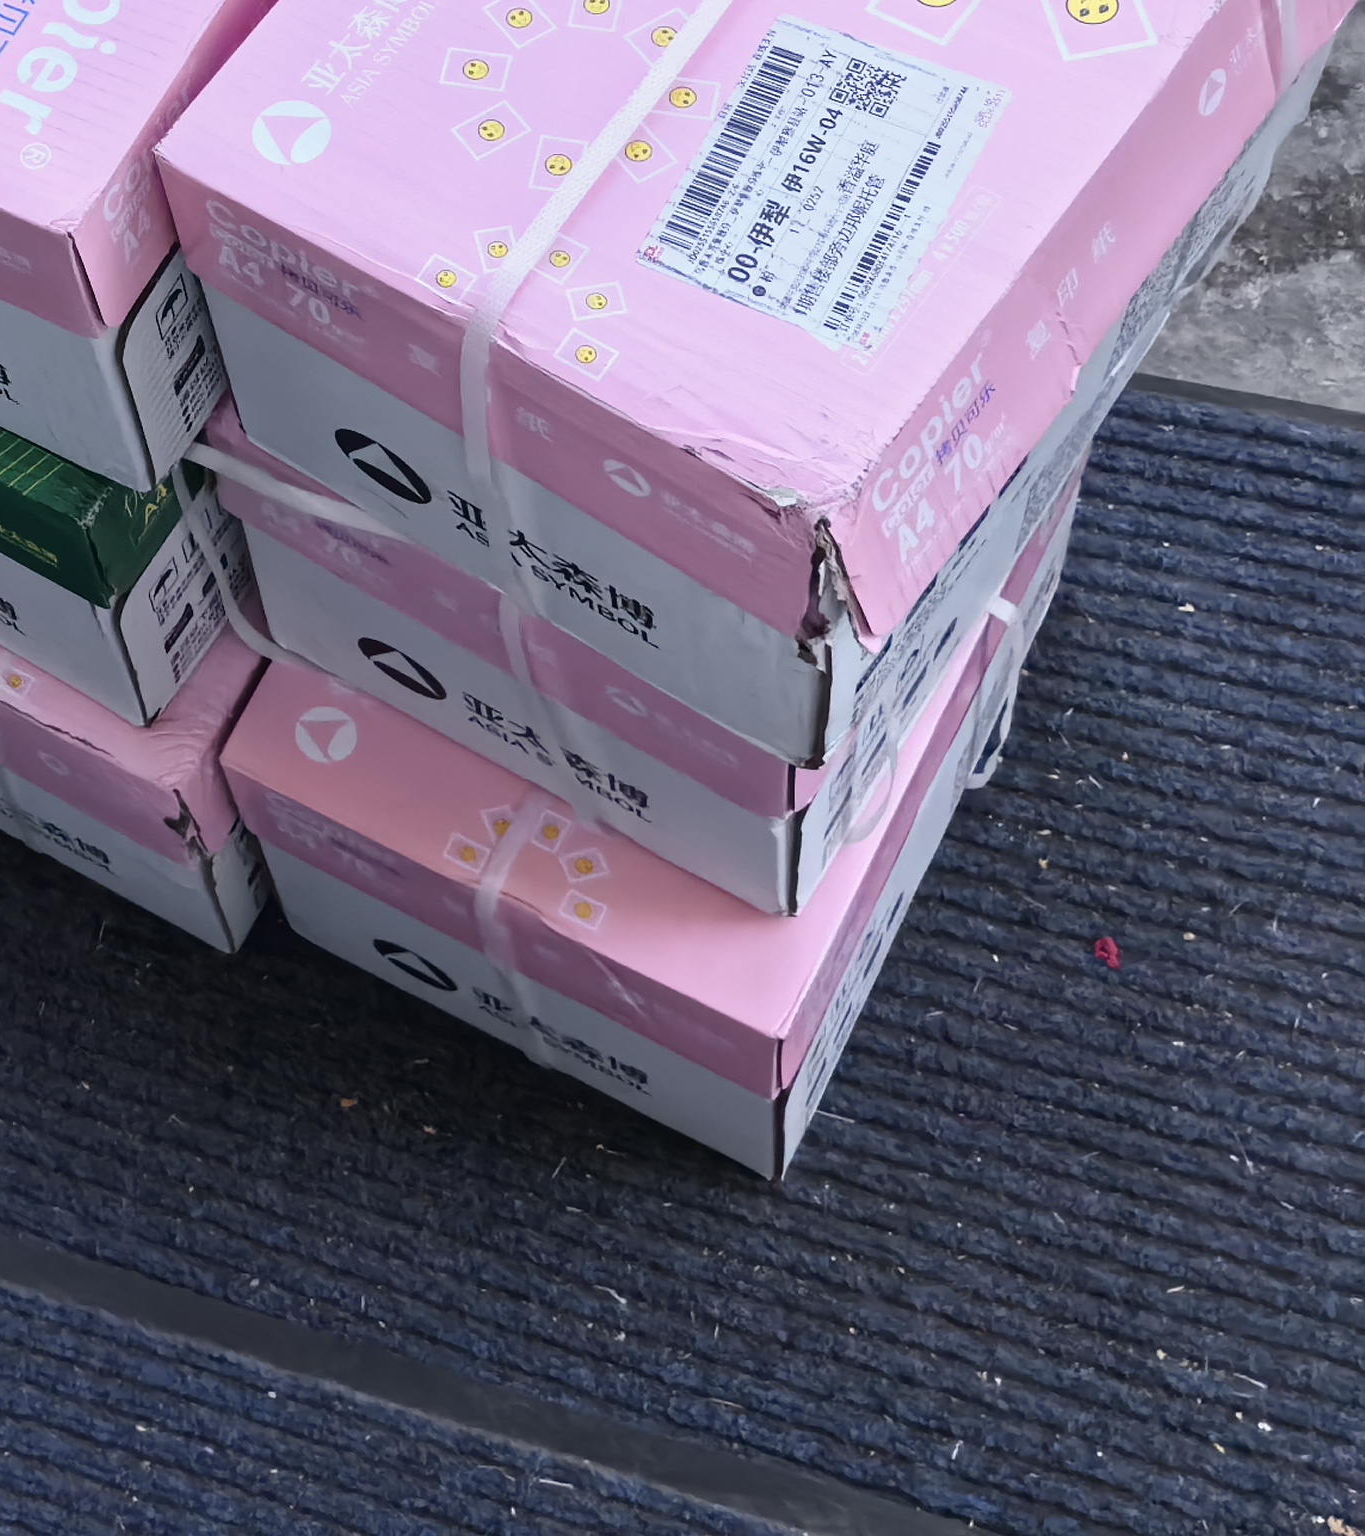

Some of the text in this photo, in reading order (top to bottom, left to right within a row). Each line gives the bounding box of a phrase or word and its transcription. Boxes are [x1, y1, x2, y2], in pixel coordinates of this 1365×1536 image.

[340, 66, 382, 108] ASIA
[725, 196, 793, 284] 00-伊犁
[779, 105, 844, 195] 伊16W-04
[801, 184, 825, 212] 0252
[835, 137, 880, 195] 香溢华庭
[206, 199, 359, 297] Copier
[284, 282, 332, 327] 70
[871, 353, 988, 514] Copier
[897, 433, 984, 556] A4 70
[448, 490, 659, 631] 亚太森博
[532, 563, 660, 650] SYMBOL
